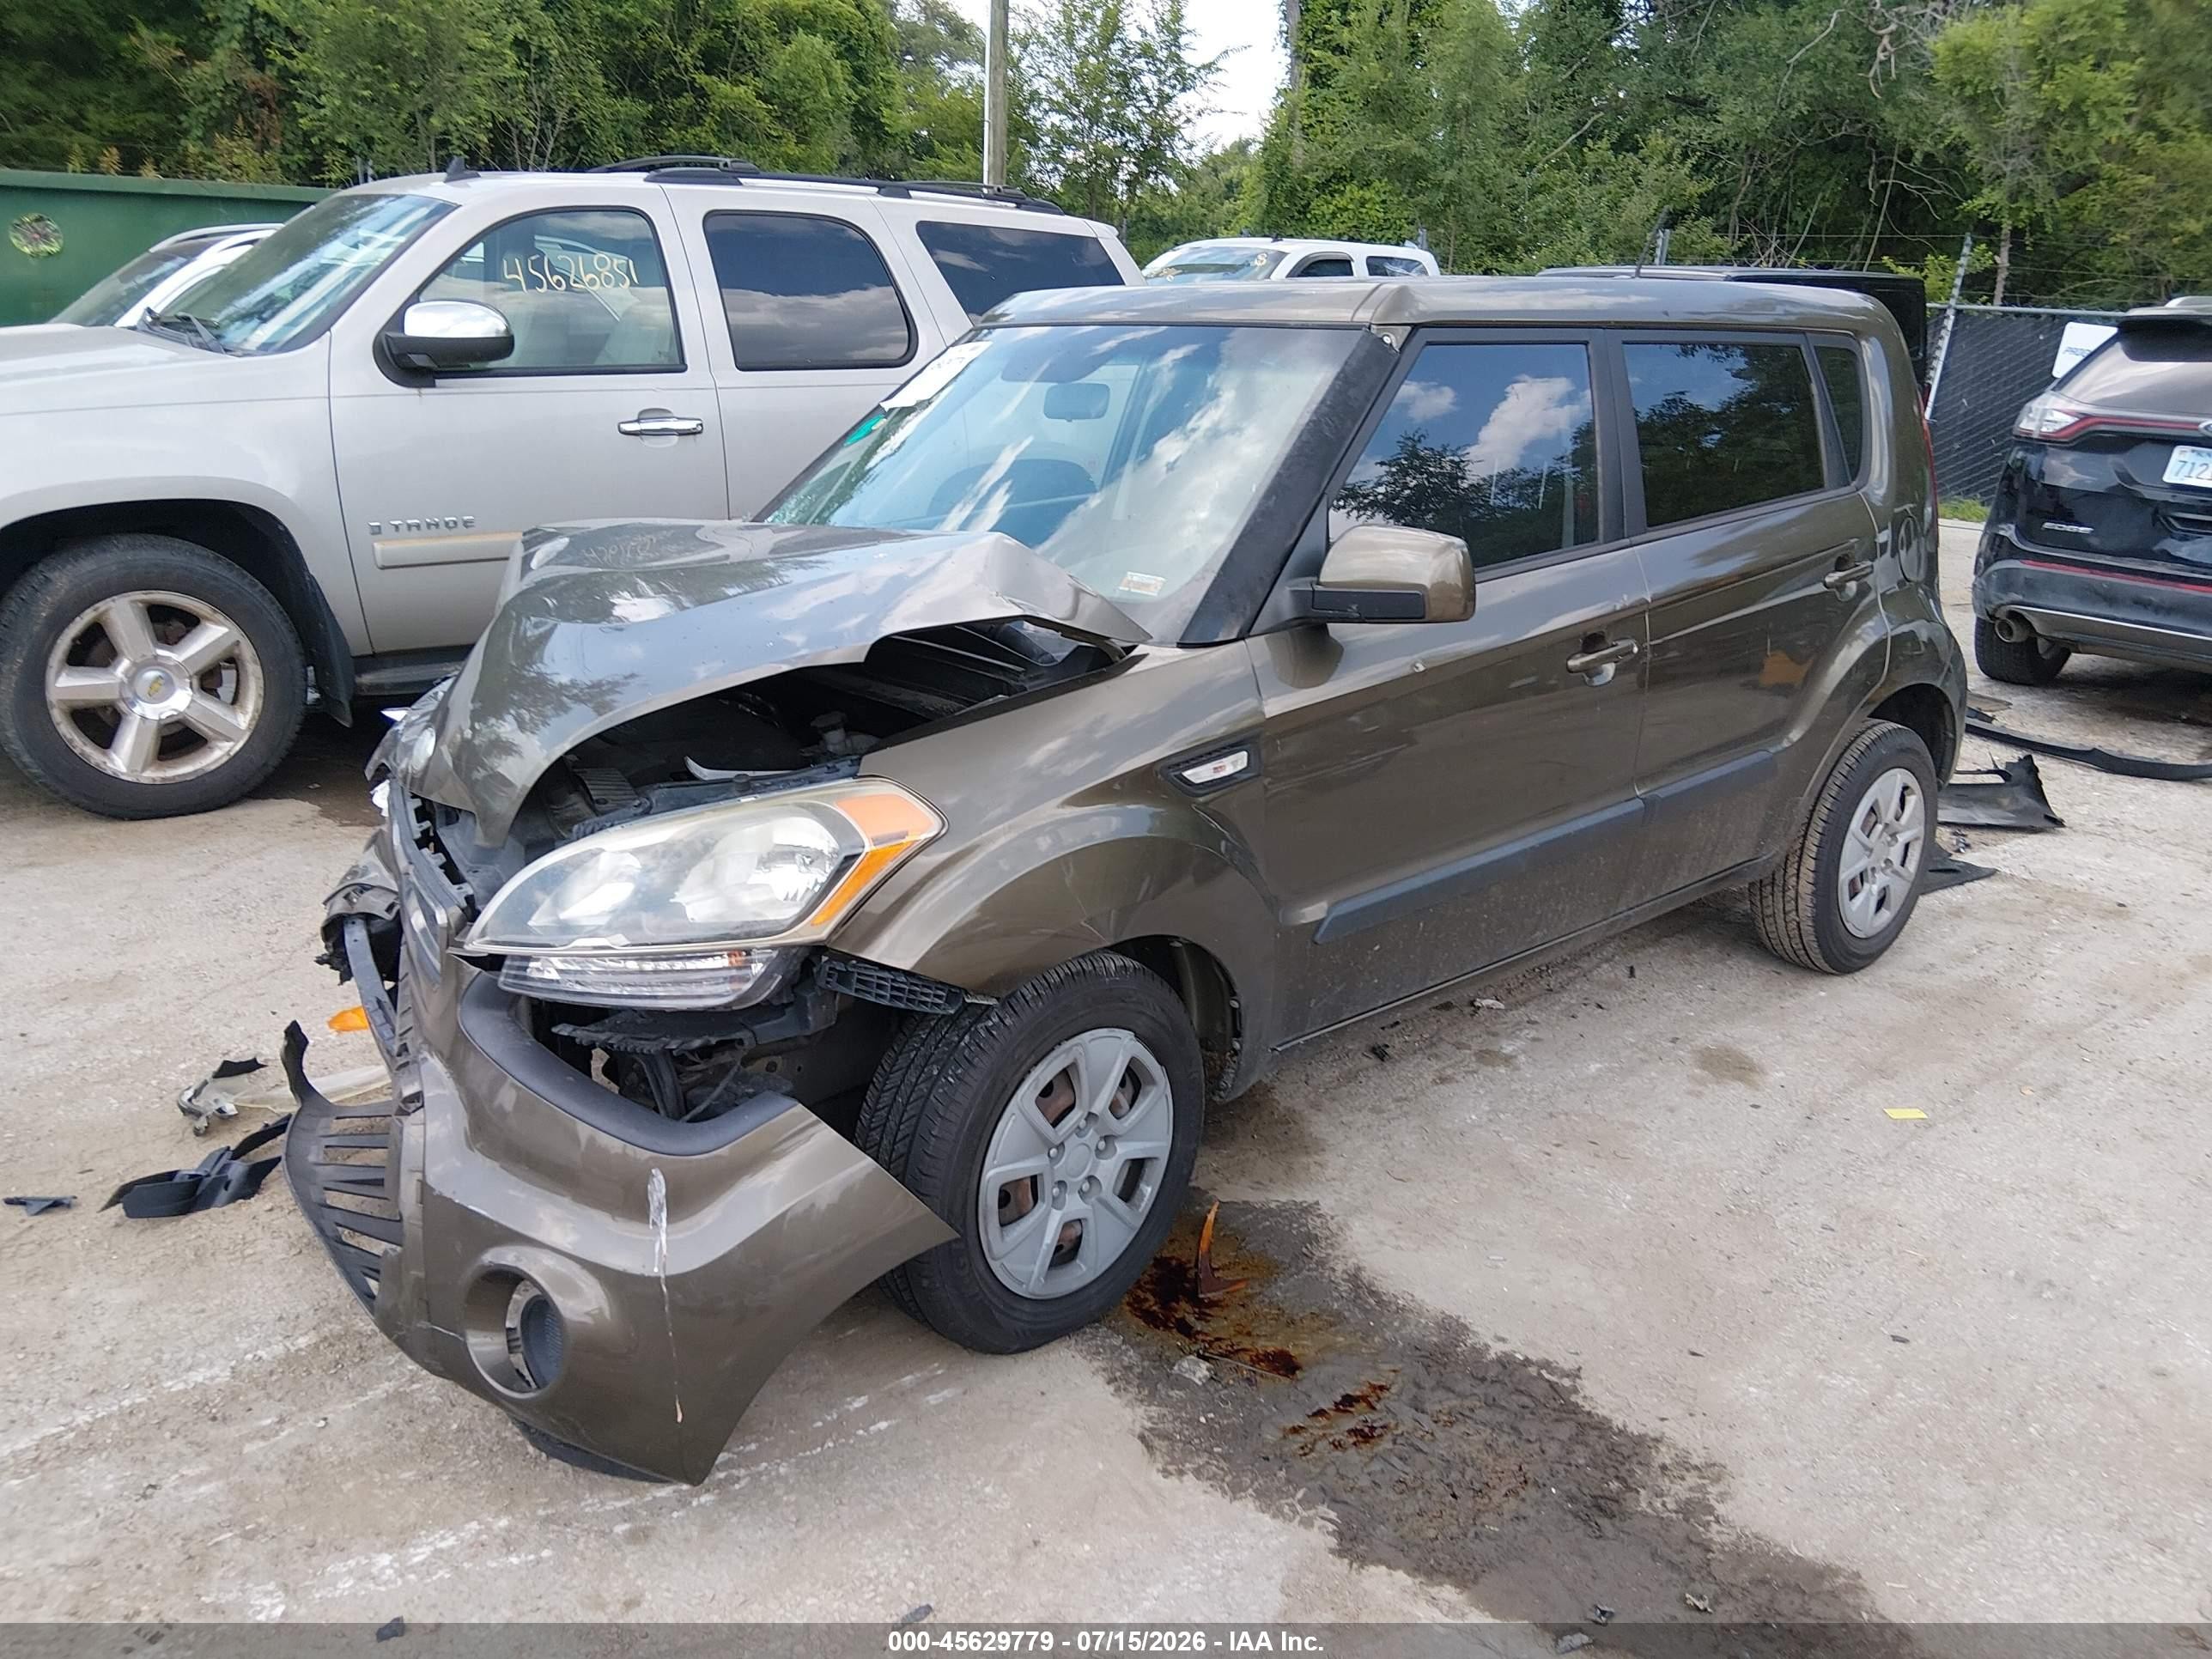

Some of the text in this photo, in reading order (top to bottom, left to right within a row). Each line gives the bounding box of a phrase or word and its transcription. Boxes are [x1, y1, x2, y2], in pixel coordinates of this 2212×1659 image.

[502, 252, 640, 294] 45626851
[2174, 459, 2212, 482] 712
[388, 515, 476, 532] TAHOE
